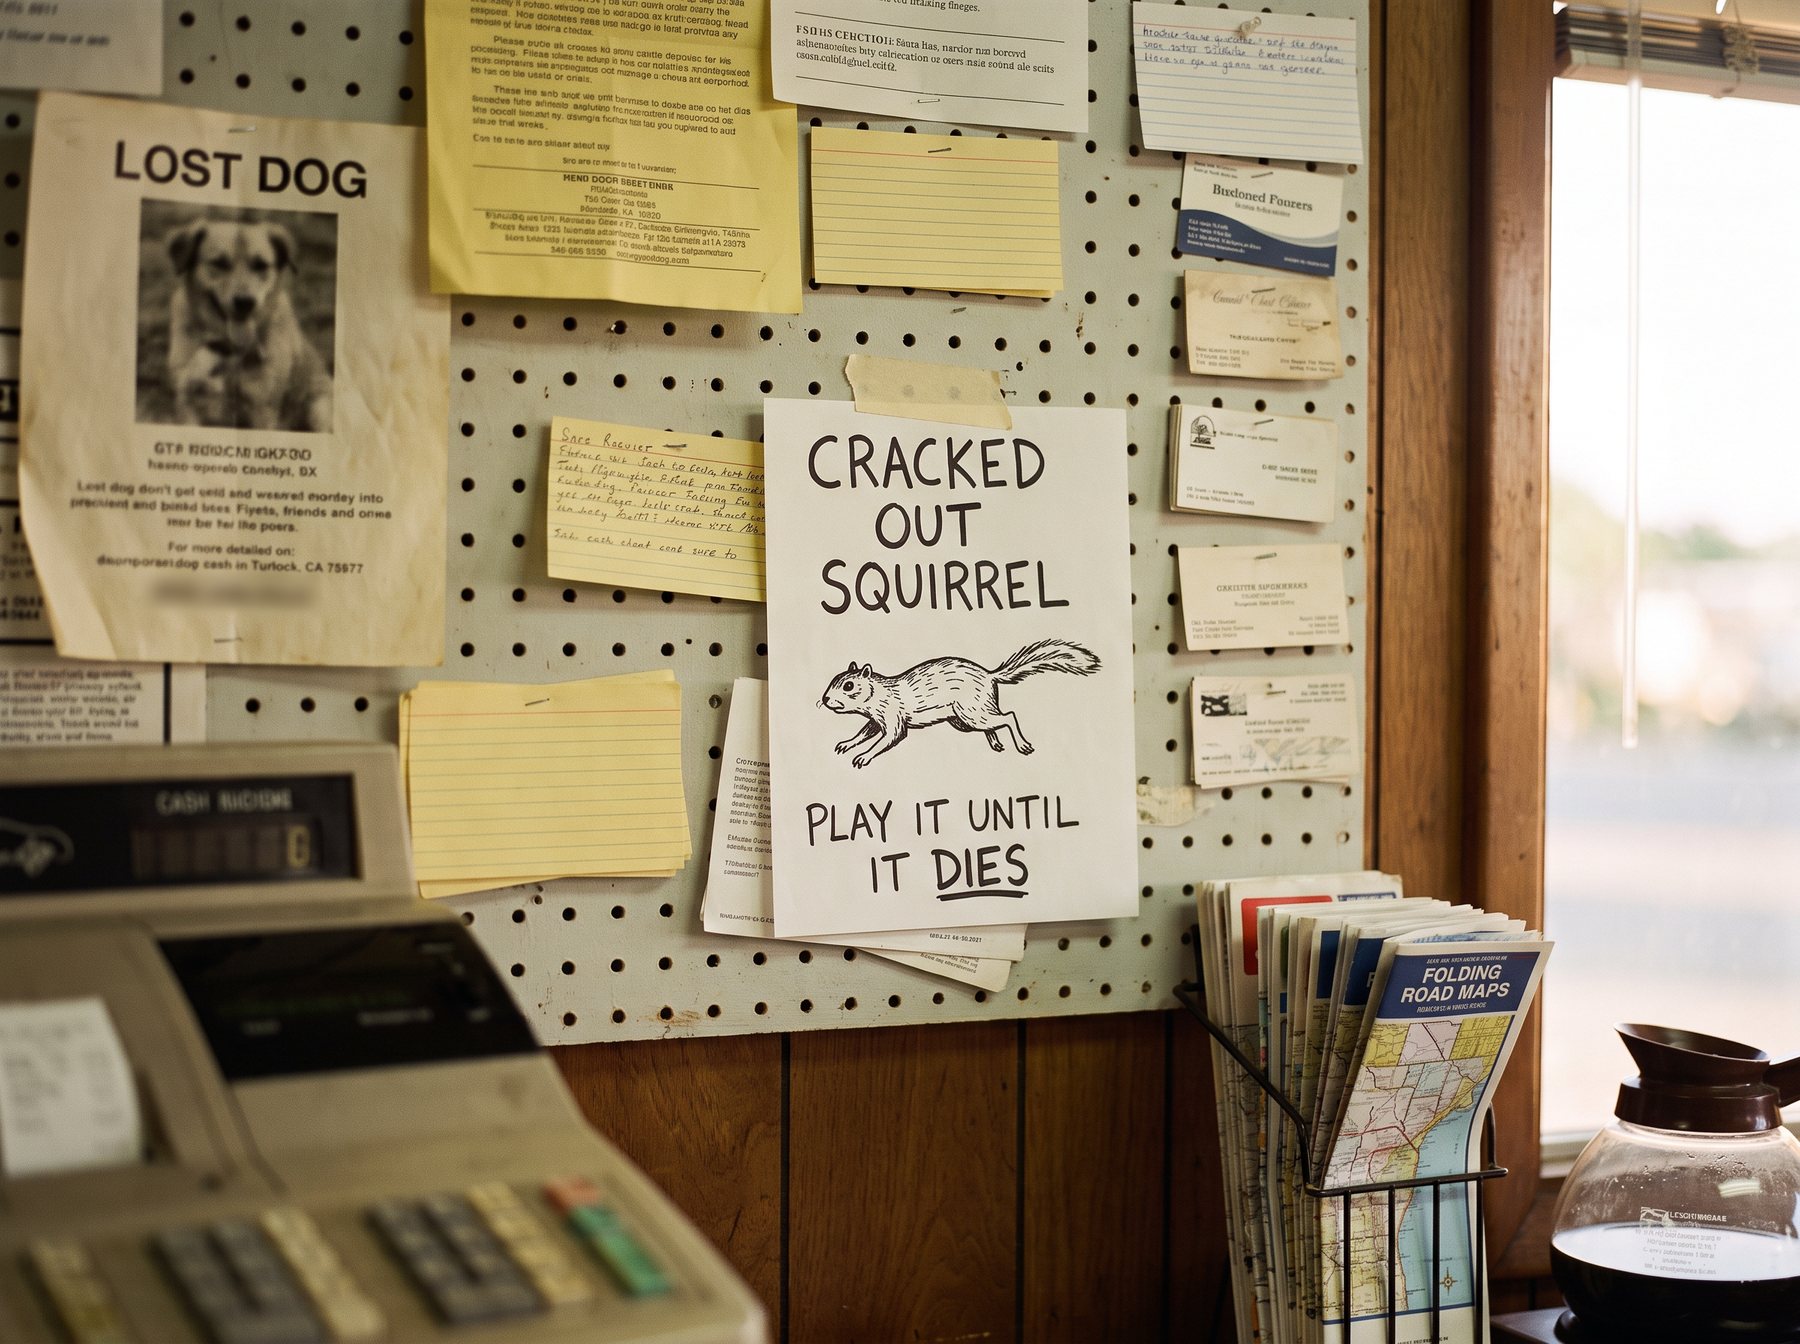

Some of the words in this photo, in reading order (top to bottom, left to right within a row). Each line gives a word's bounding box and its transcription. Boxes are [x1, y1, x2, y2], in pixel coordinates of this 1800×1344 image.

[717, 8, 730, 16] the
[115, 141, 243, 190] LOST
[259, 156, 368, 199] DOG
[808, 434, 1046, 490] CRACKED
[359, 492, 384, 504] into
[283, 506, 327, 518] friends
[331, 507, 355, 519] and
[875, 502, 982, 550] OUT
[167, 541, 188, 553] For
[191, 543, 222, 554] more
[226, 544, 272, 556] detailed
[725, 547, 738, 560] to
[236, 560, 248, 570] in
[305, 562, 324, 573] CA
[820, 559, 1070, 615] SQUIRREL
[806, 800, 893, 846] PLAY
[916, 798, 950, 836] IT
[968, 795, 1080, 832] UNTIL
[871, 852, 911, 893] IT
[930, 843, 1029, 892] DIES
[1422, 964, 1503, 984] FOLDING
[1400, 985, 1454, 1003] ROAD
[1457, 982, 1511, 1000] MAPS
